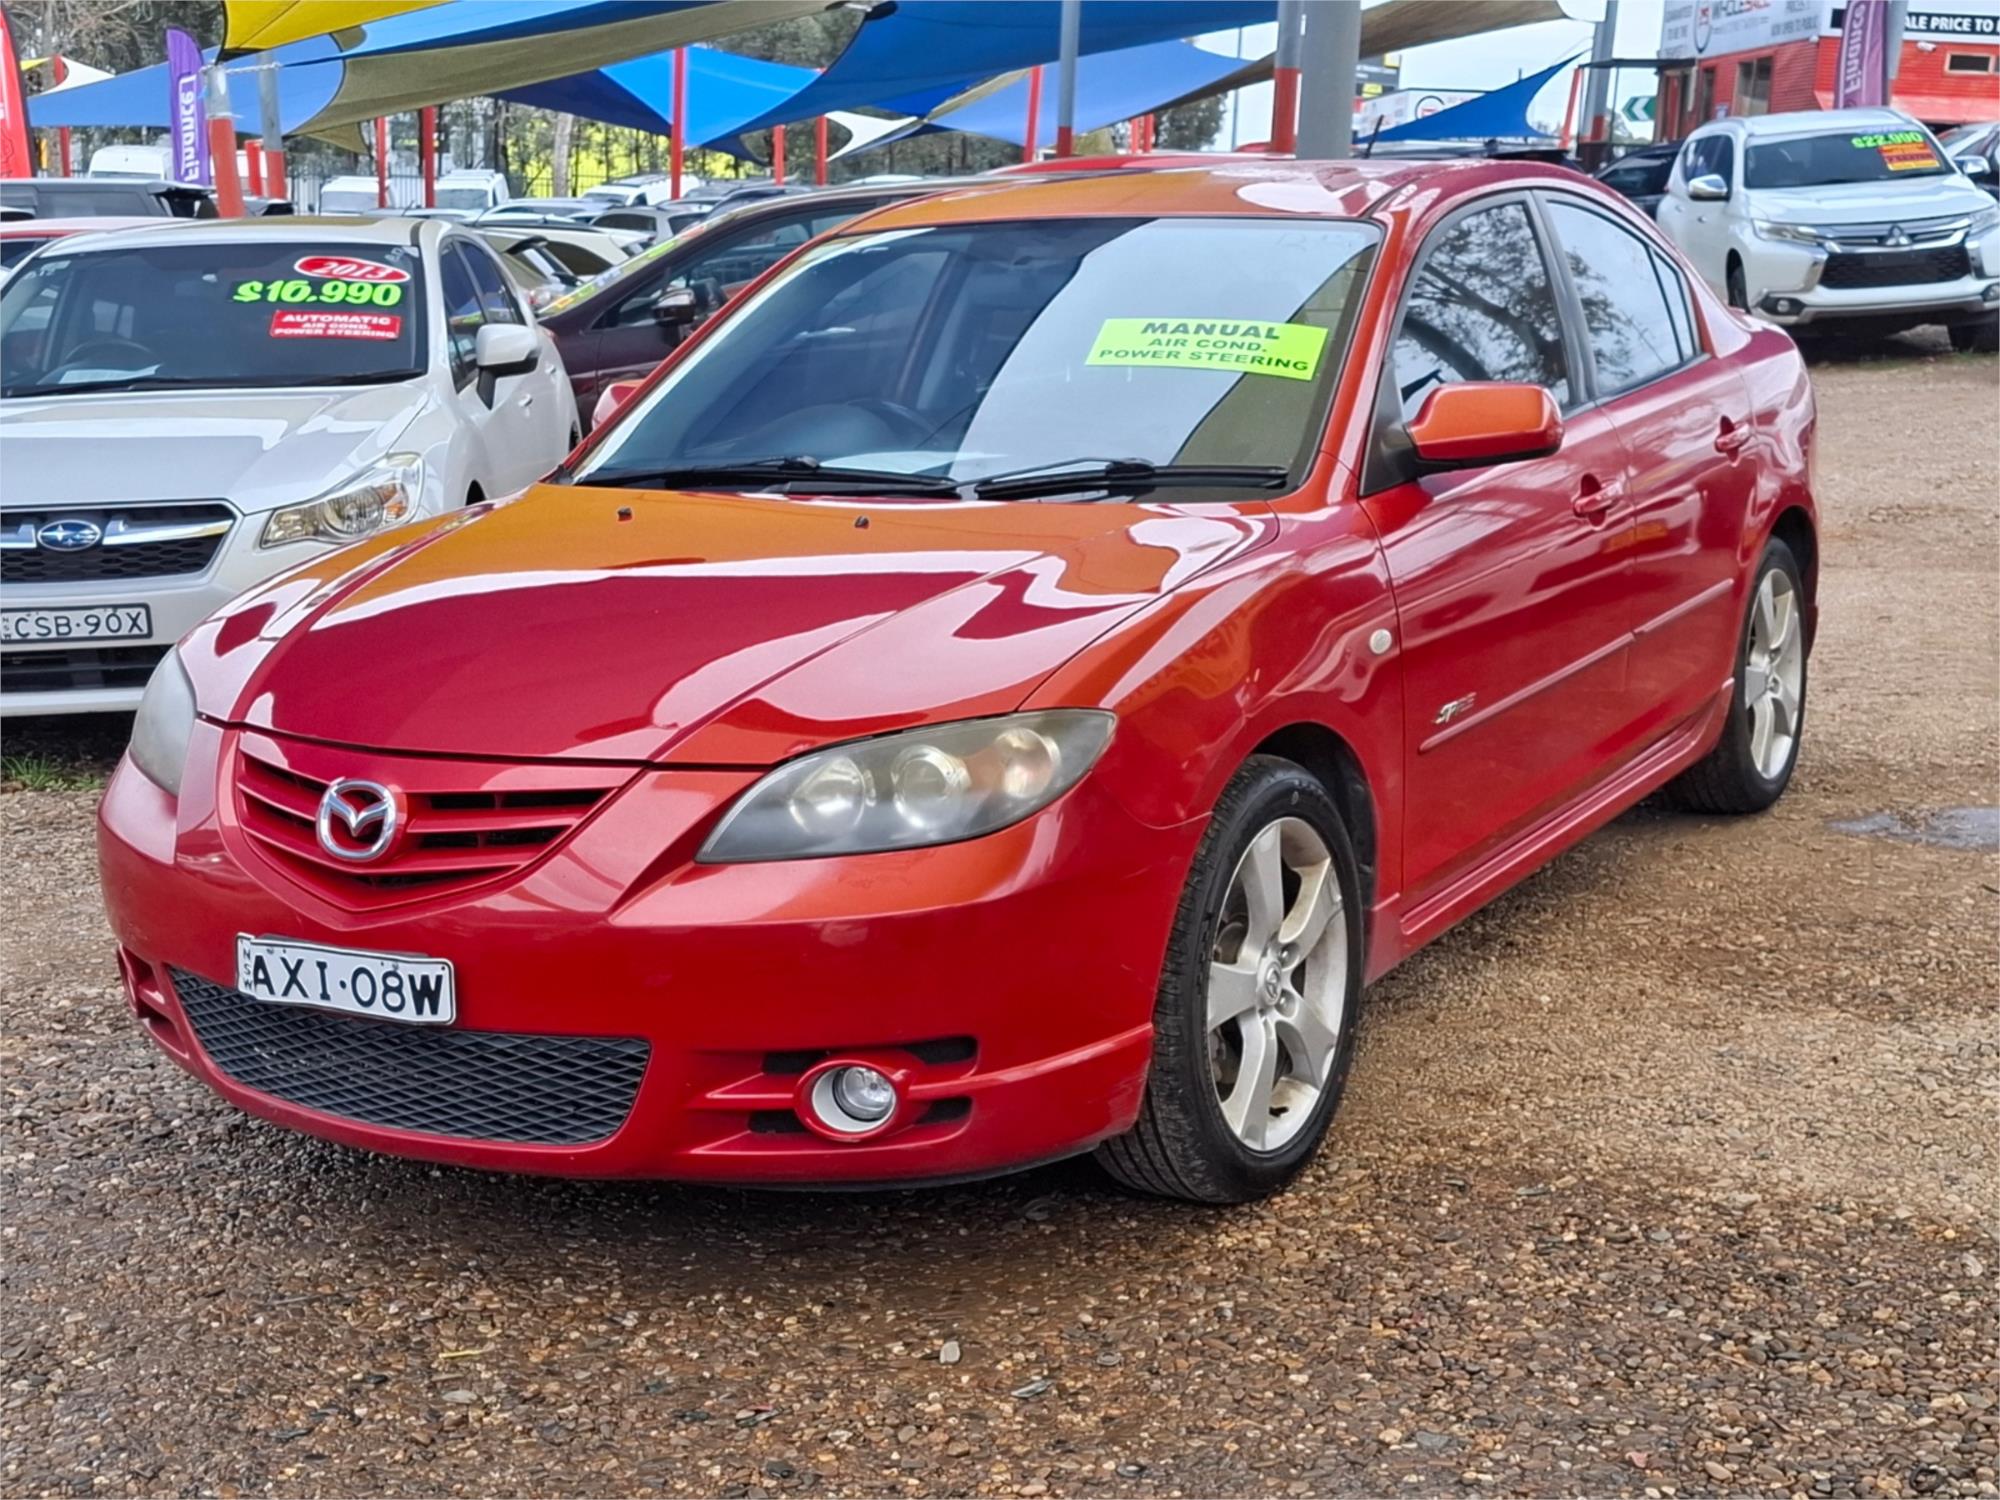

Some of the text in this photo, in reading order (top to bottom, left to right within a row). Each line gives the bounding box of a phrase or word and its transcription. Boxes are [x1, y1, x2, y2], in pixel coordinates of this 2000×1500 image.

[1930, 15, 1972, 31] PRICE
[1974, 18, 1994, 32] TO
[313, 261, 393, 278] 2013
[282, 314, 391, 325] AUTOMATIC
[326, 328, 398, 338] STEERING
[1140, 322, 1280, 340] MANUAL
[1148, 338, 1267, 352] AIR COND.
[1099, 349, 1309, 372] POWER STEERING
